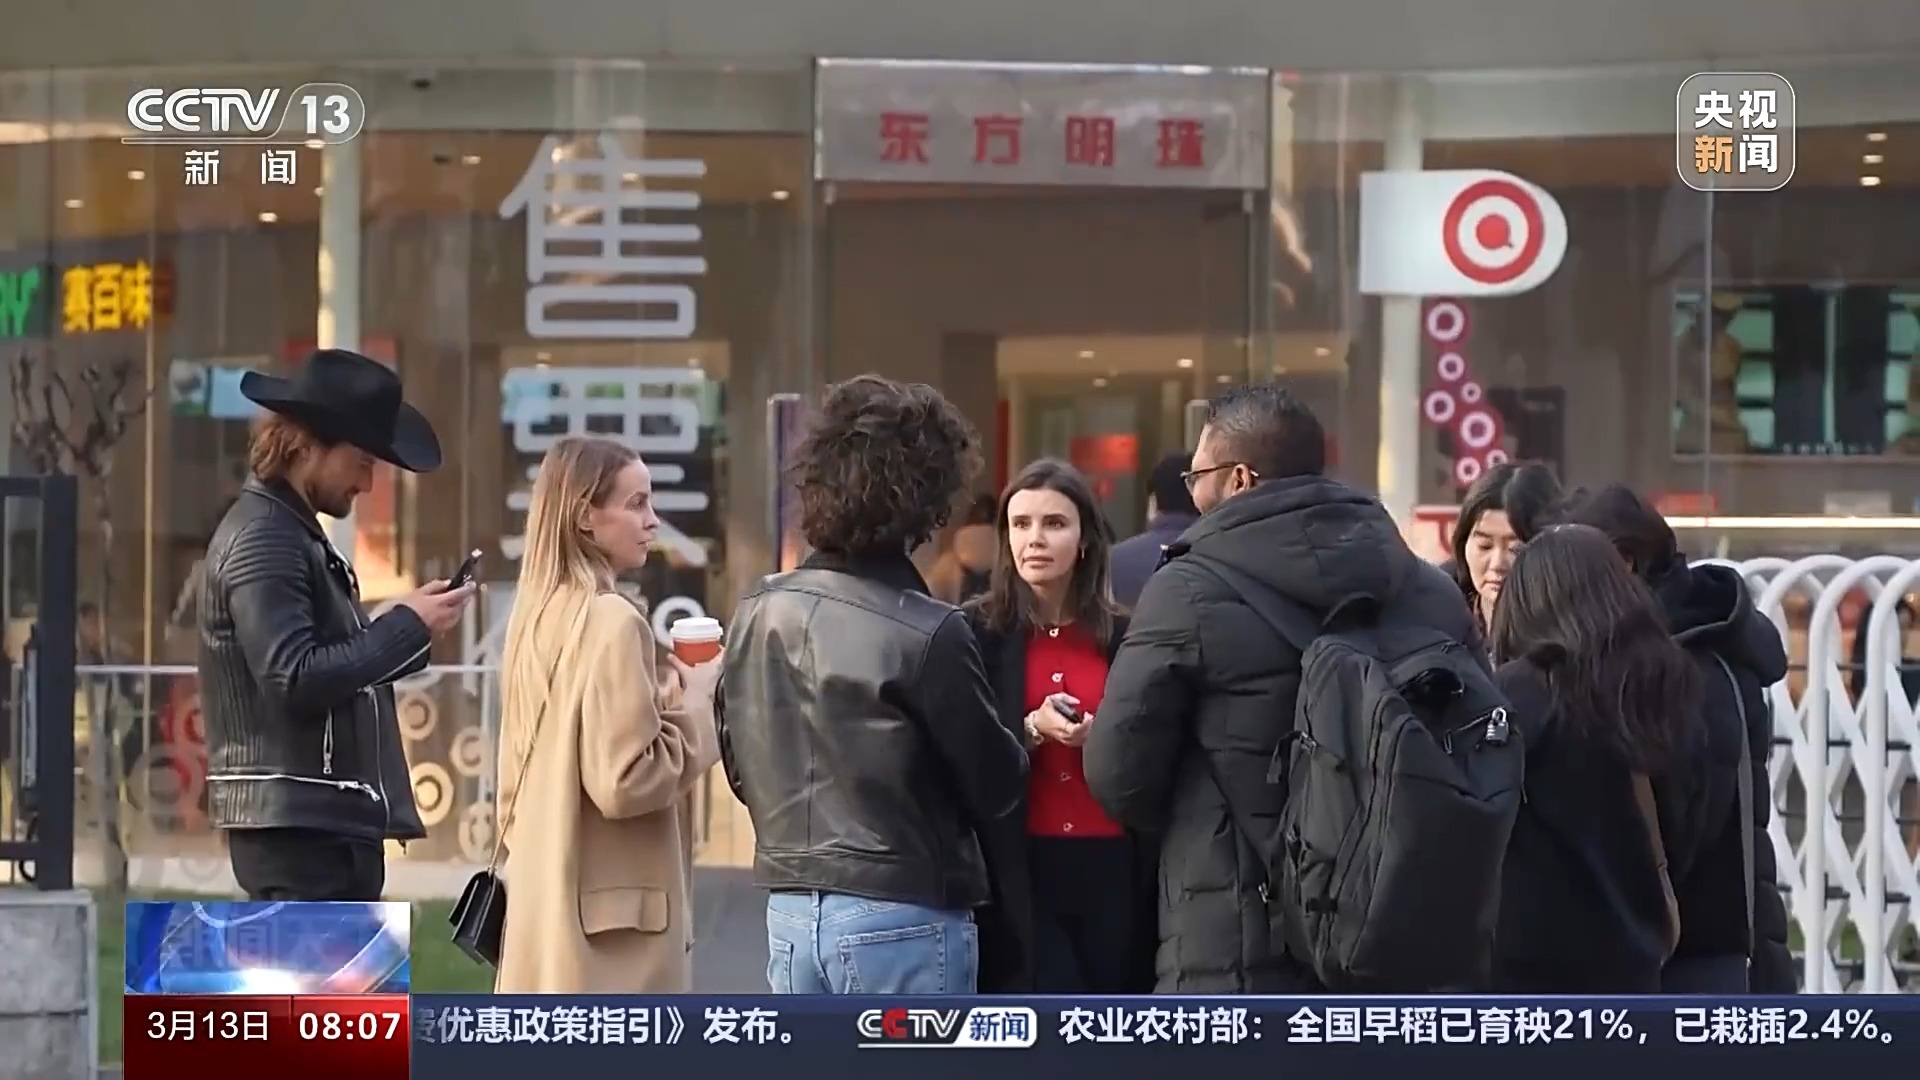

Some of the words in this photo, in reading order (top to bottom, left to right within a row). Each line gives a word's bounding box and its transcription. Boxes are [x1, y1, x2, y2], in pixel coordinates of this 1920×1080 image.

[880, 112, 1204, 167] 东方明珠
[63, 259, 151, 333] 赛百味
